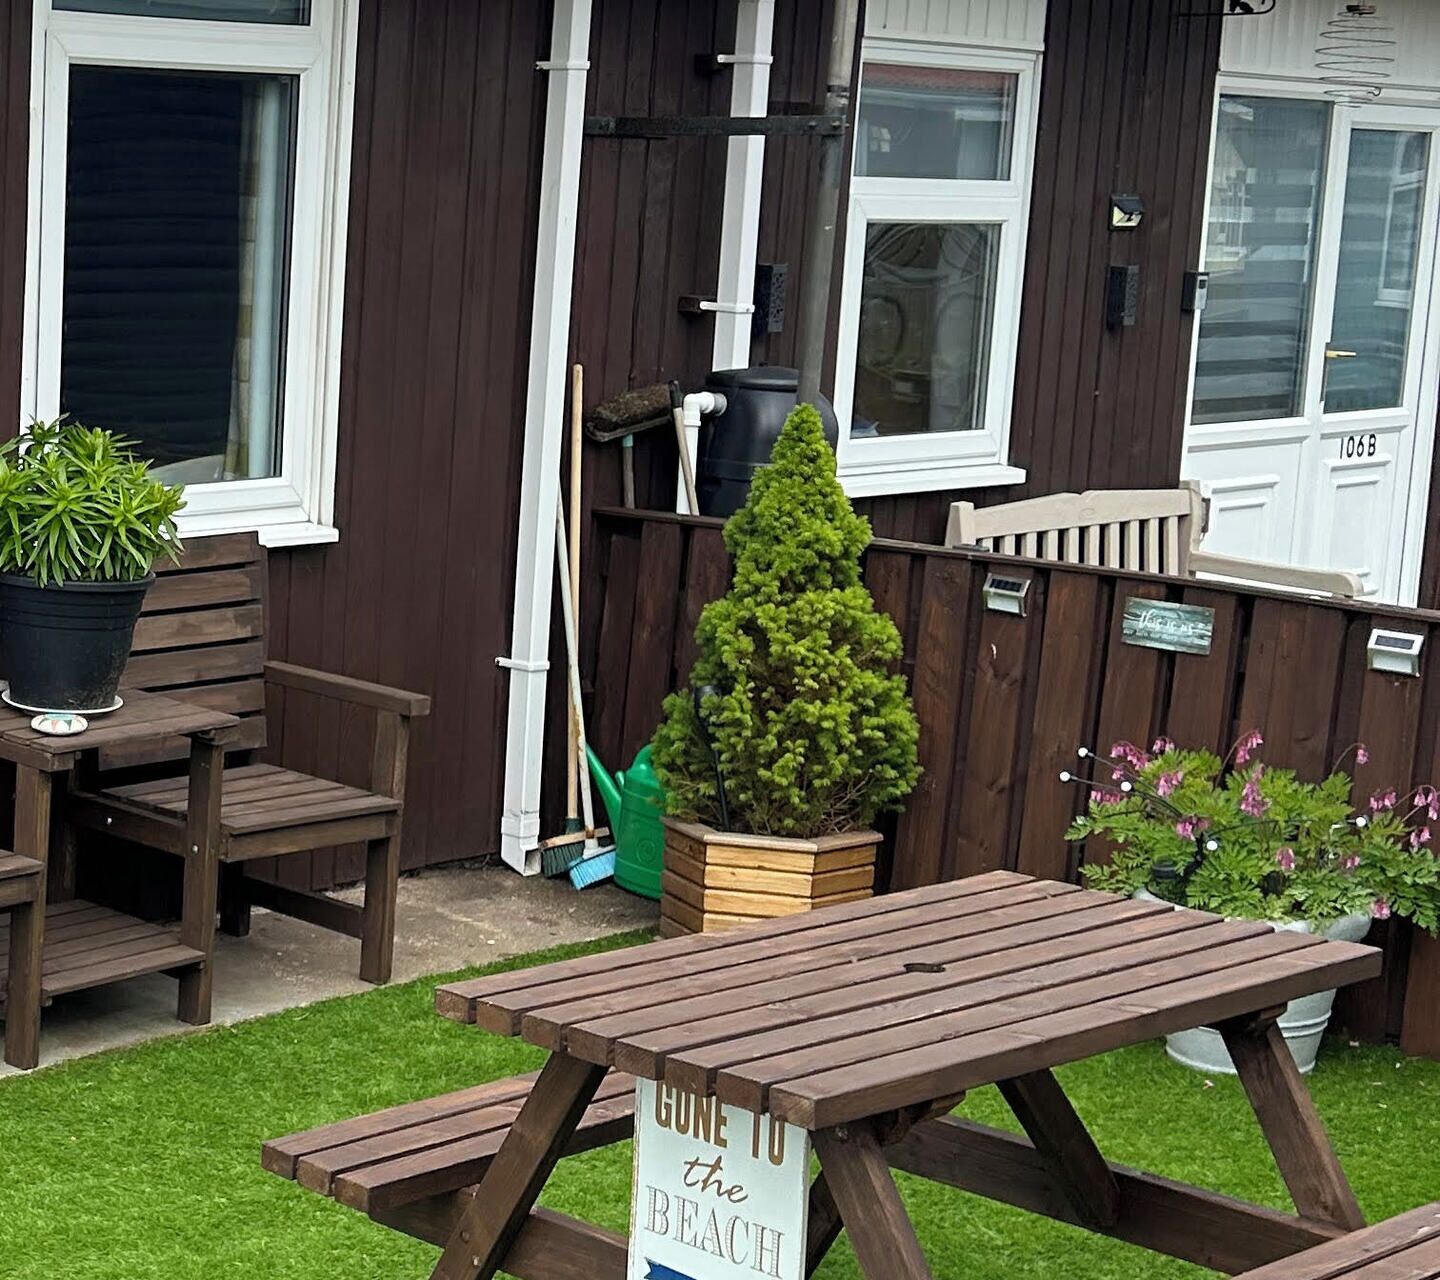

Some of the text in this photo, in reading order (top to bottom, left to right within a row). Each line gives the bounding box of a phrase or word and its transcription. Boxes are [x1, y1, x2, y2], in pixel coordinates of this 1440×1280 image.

[1340, 433, 1377, 460] 106B
[655, 1080, 728, 1149] GONE
[683, 1154, 749, 1204] the
[643, 1184, 786, 1280] BEACH
